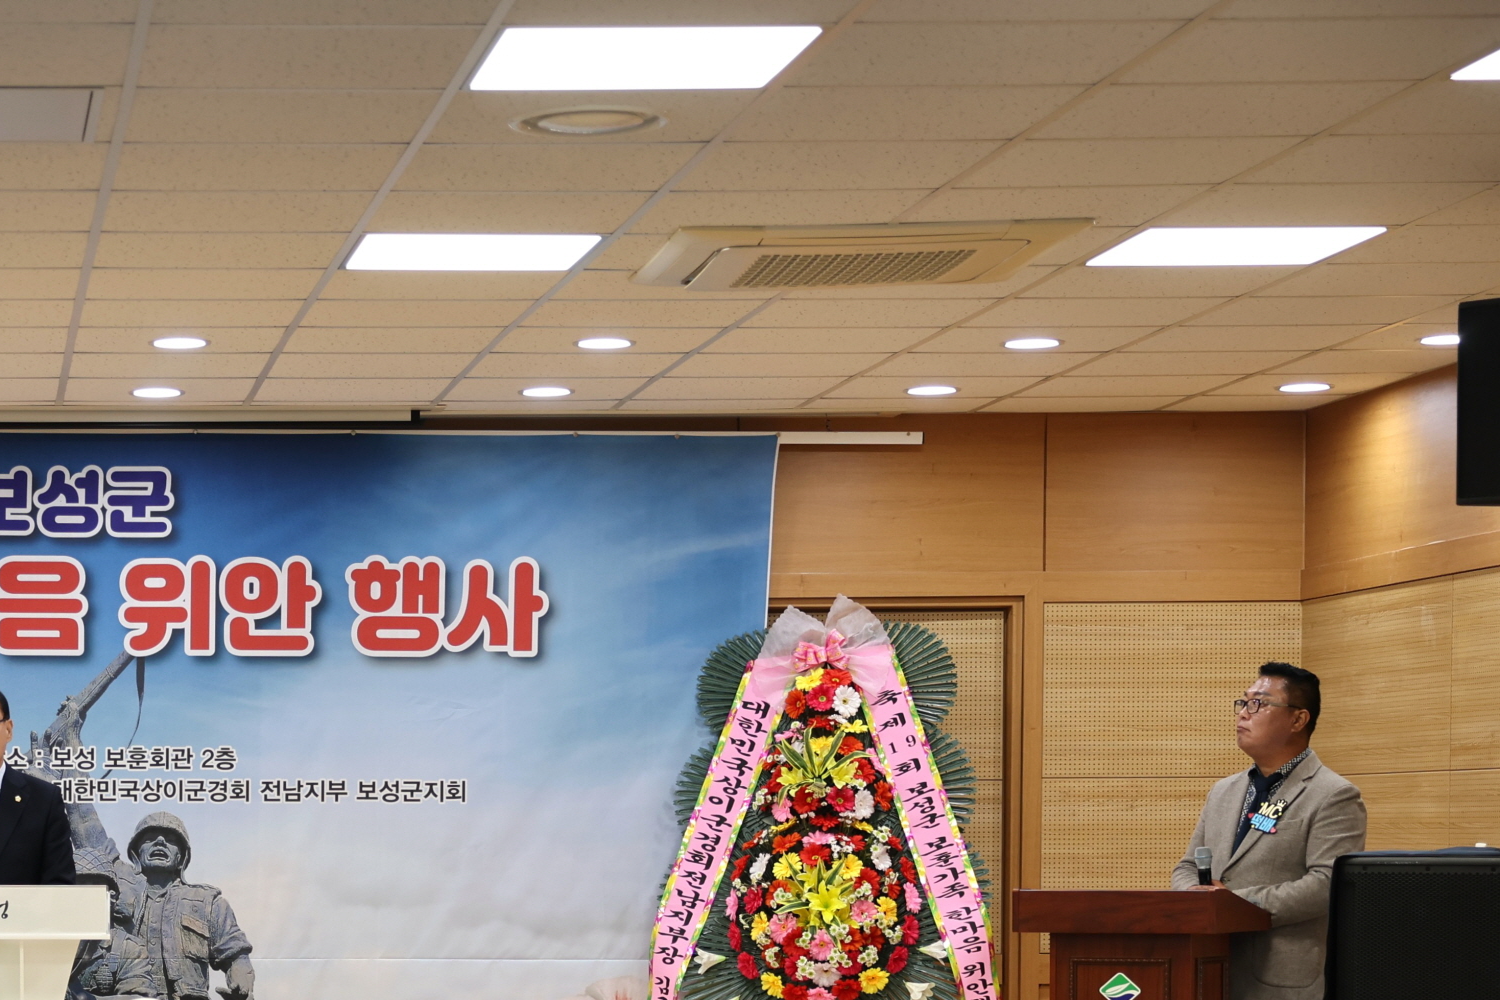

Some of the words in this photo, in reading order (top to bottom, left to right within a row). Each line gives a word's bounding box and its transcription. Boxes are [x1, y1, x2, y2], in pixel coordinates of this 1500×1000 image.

[119, 554, 322, 658] 위안
[345, 554, 550, 659] 행사
[51, 747, 96, 770] 보성
[104, 747, 194, 771] 보훈회관
[201, 747, 237, 770] 2층
[260, 779, 348, 803] 전남지부
[355, 779, 467, 803] 보성군지회
[902, 781, 944, 829] 보성군
[1258, 801, 1283, 819] MC
[924, 835, 970, 899] 보훈가족
[946, 906, 986, 954] 한마음
[961, 961, 994, 995] 위안
